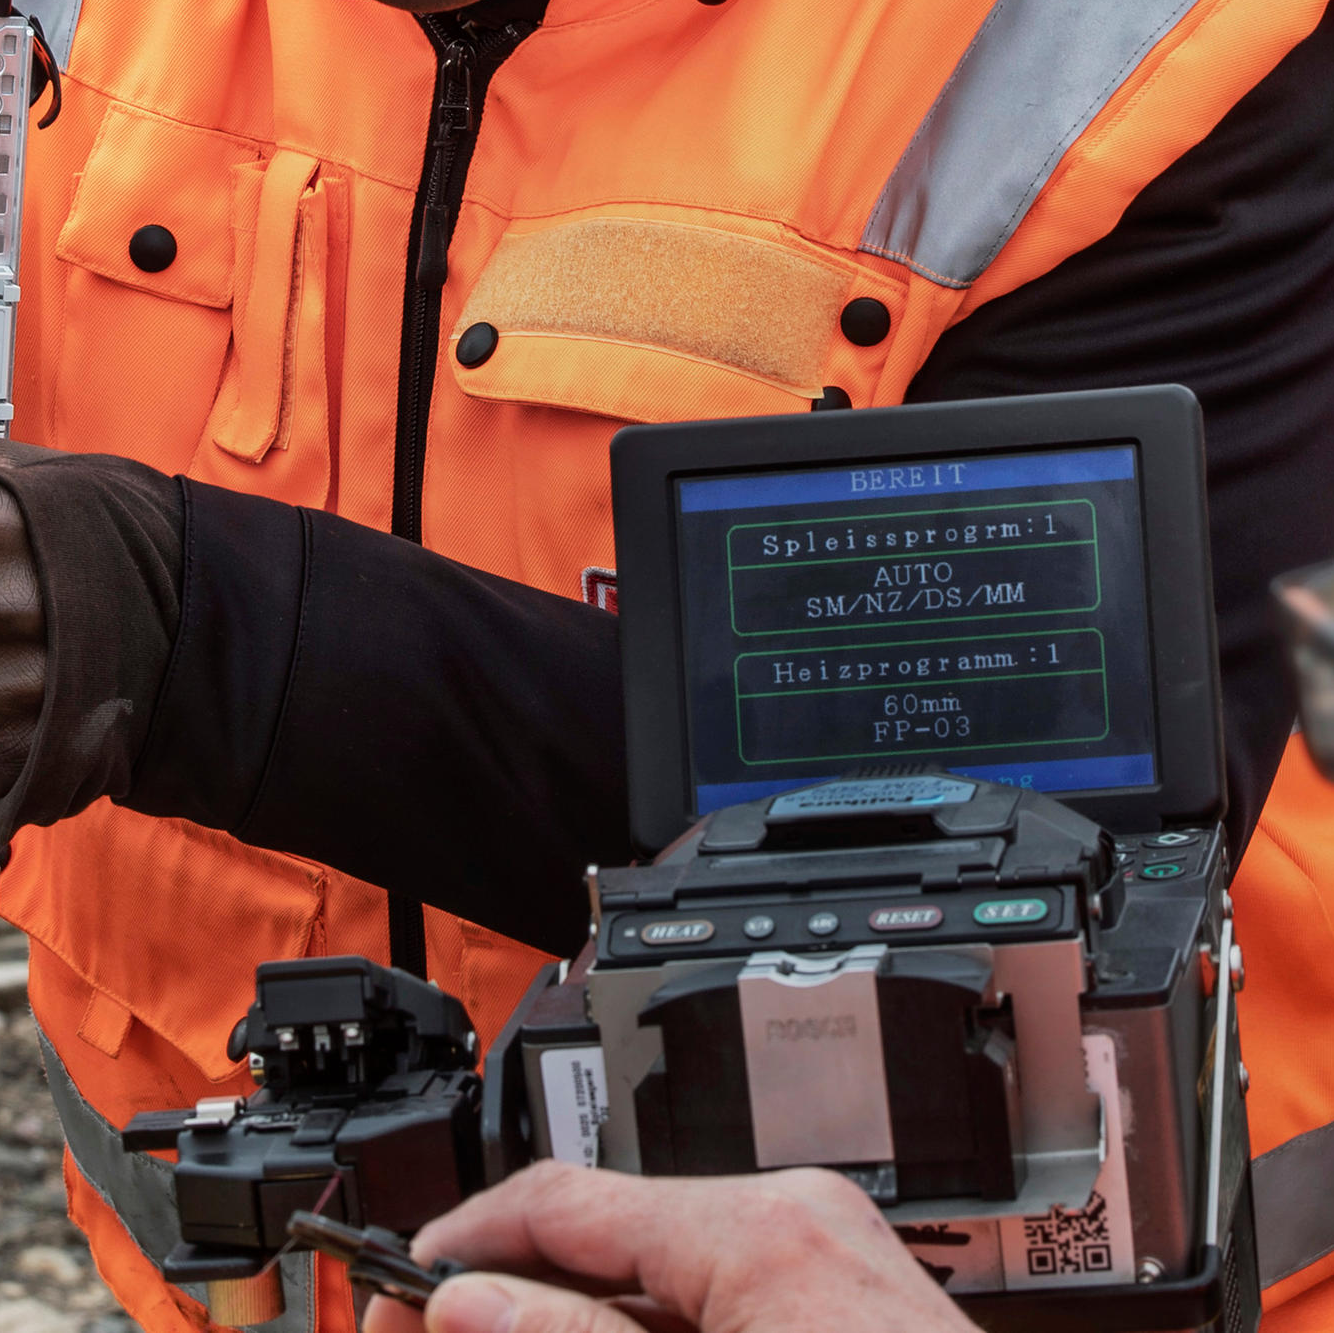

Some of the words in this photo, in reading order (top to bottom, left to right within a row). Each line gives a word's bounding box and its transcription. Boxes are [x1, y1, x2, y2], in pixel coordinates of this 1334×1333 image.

[850, 463, 967, 492] BEREIT
[873, 561, 953, 588] AUTO
[807, 582, 1026, 618] SM/NZ/DS/MM
[883, 694, 962, 716] 60mm
[874, 716, 971, 743] FP-03
[874, 909, 936, 926] RESET
[983, 903, 1037, 919] SET
[650, 924, 704, 939] HEAT
